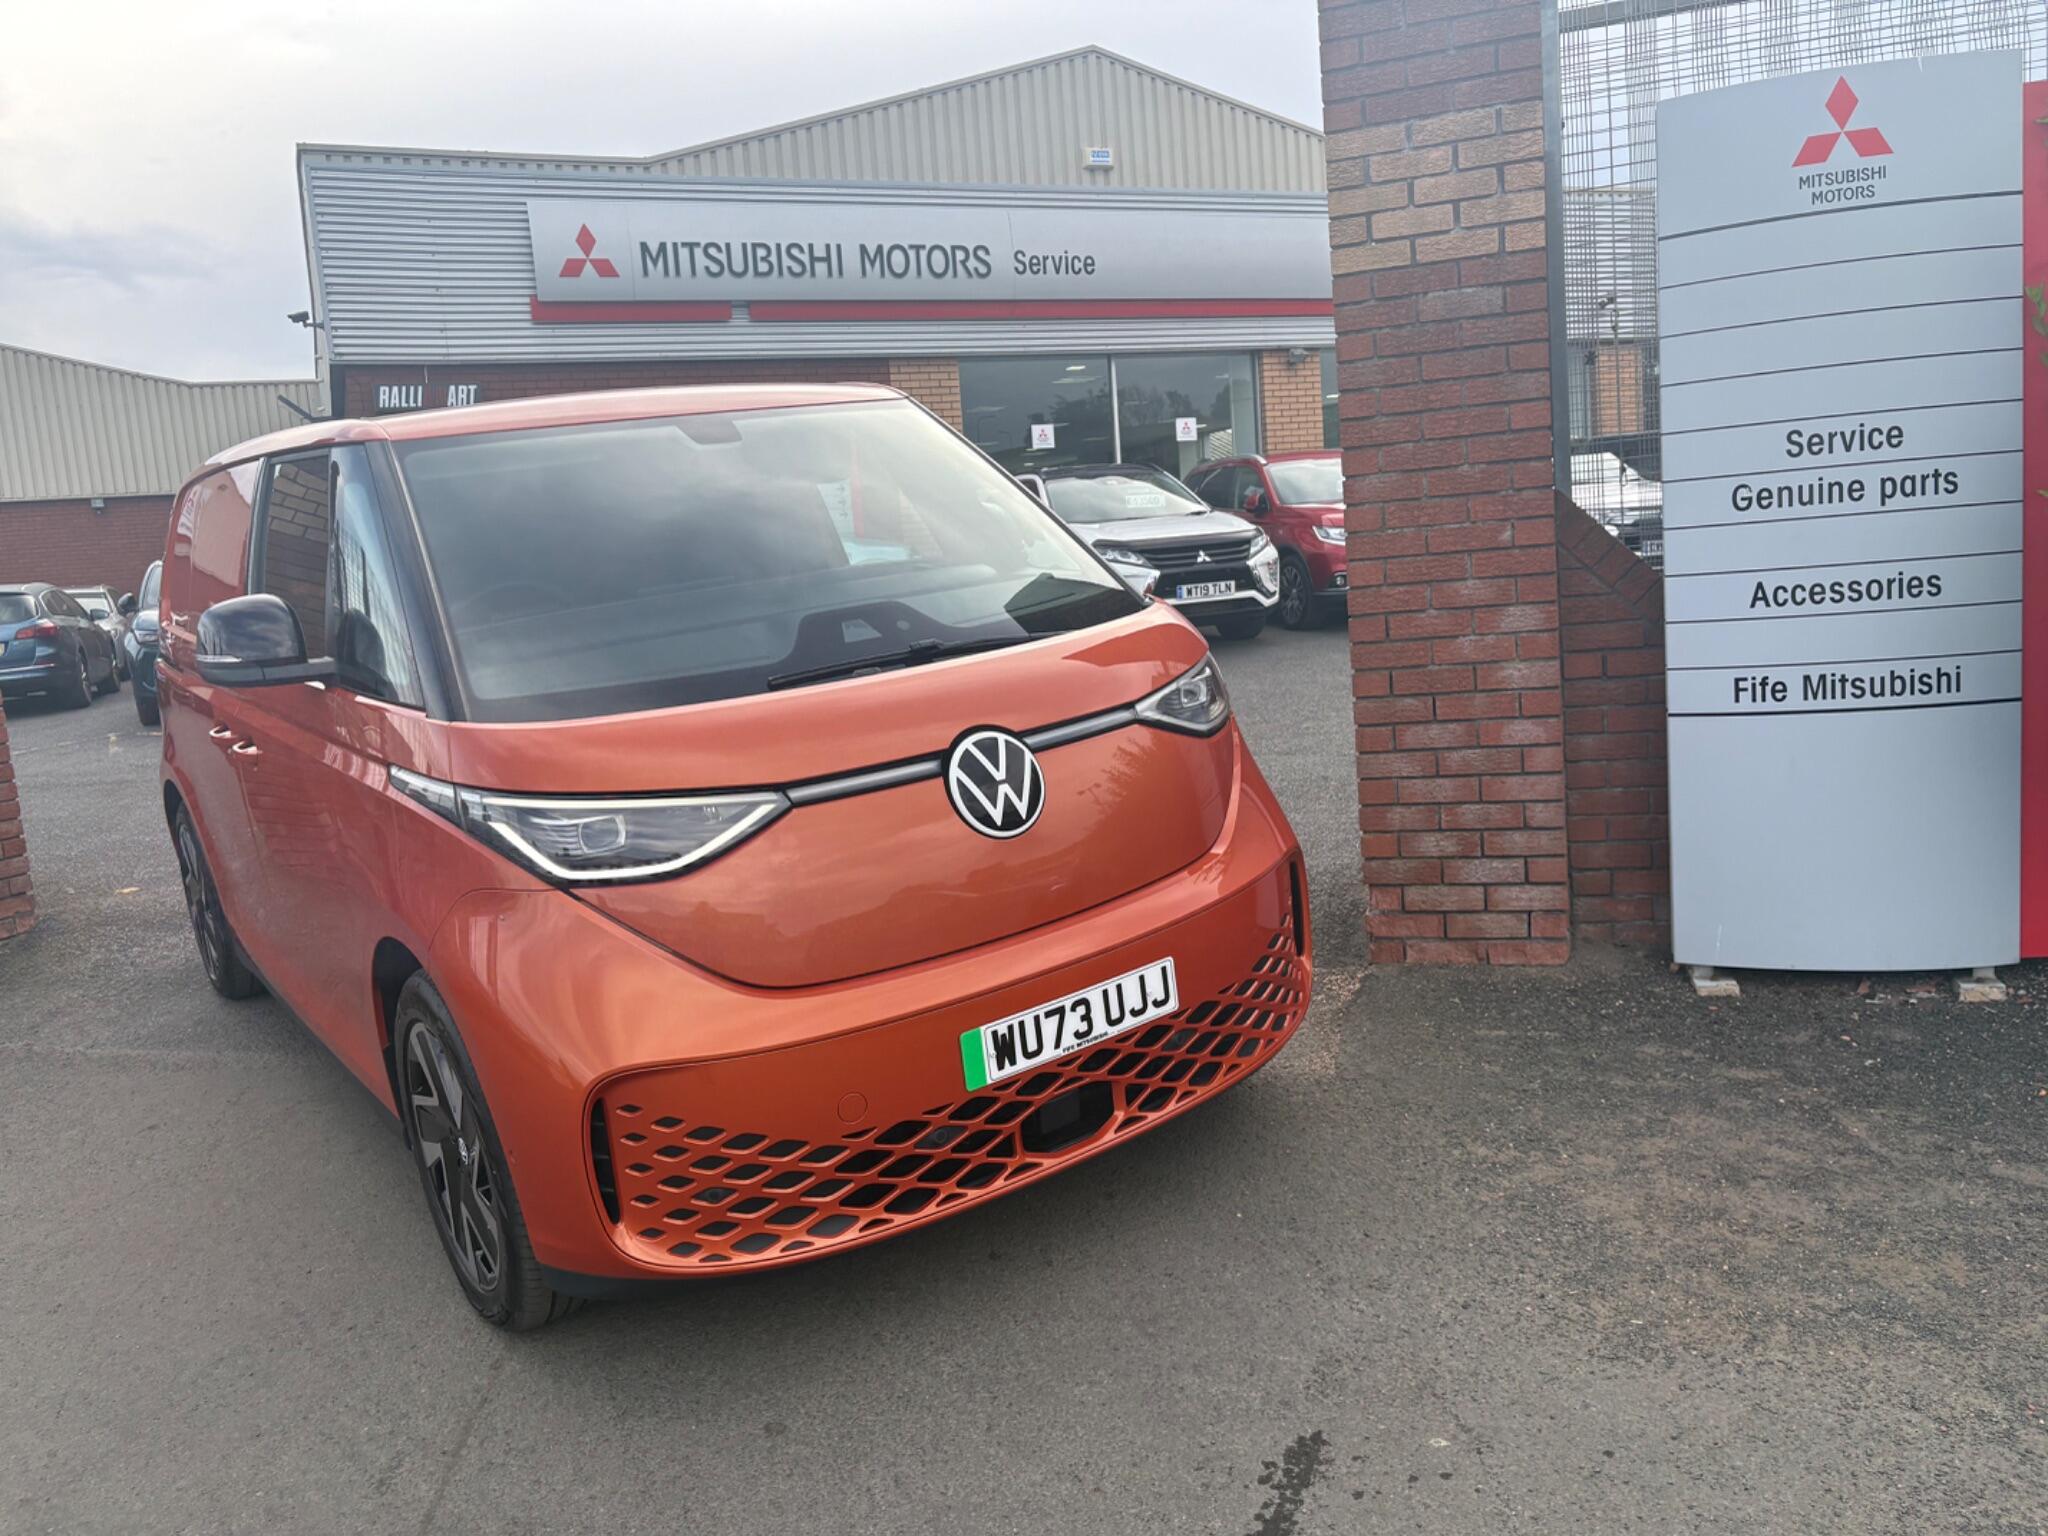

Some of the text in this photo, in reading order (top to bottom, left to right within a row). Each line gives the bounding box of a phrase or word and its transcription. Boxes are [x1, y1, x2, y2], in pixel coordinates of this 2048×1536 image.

[1799, 166, 1886, 189] MITSUBISHI
[1811, 185, 1875, 205] MOTORS
[640, 241, 1096, 280] MITSUBISHI MOTORS Service
[379, 384, 477, 408] RALLI ART
[1785, 423, 1905, 458] Service
[1731, 468, 1959, 511] Genuine parts
[1185, 584, 1209, 597] WT19
[1212, 582, 1232, 595] TLN
[1749, 571, 1943, 609] Accessories
[1733, 665, 1962, 704] Fife Mitsubishi
[991, 966, 1171, 1070] WU73 UJJ
